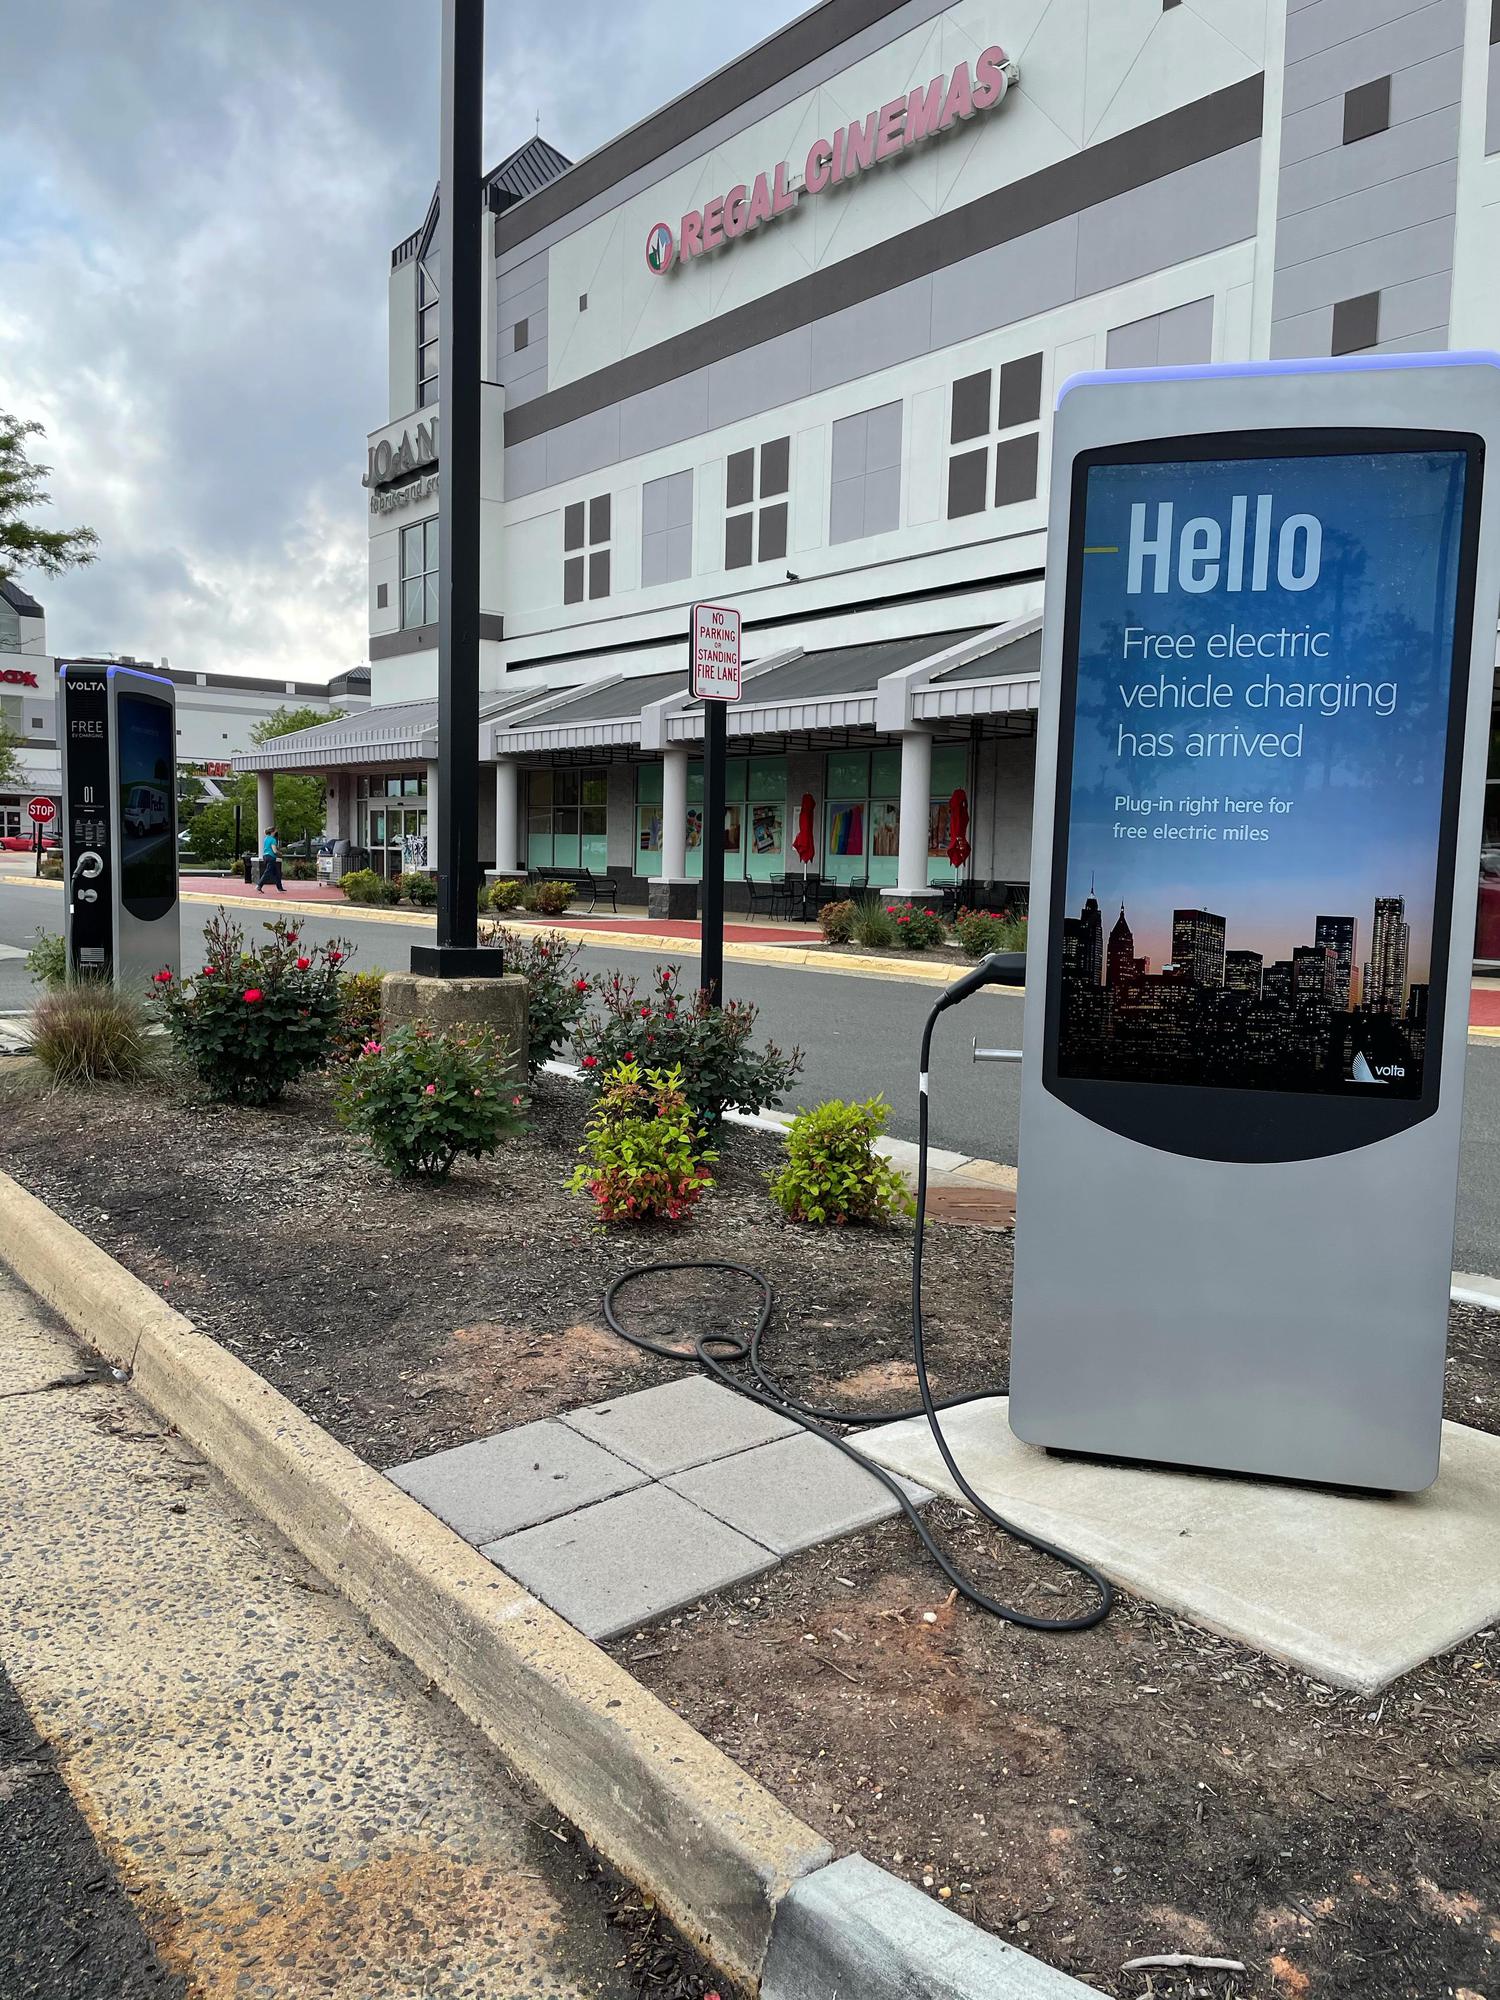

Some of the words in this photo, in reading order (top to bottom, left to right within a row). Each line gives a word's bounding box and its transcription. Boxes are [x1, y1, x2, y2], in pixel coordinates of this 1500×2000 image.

[680, 161, 798, 264] REGAL
[804, 45, 1008, 195] CINEMAS
[1126, 494, 1322, 594] Hello
[712, 612, 724, 625] NO
[700, 626, 736, 642] PARKING
[1122, 627, 1195, 659] Free
[1206, 623, 1330, 659] electric
[698, 648, 737, 665] STANDING
[697, 663, 715, 679] FIRE
[717, 666, 738, 682] LANE
[66, 681, 106, 691] VOLTA
[1118, 674, 1233, 709] vehicle
[1245, 673, 1398, 716] charging
[71, 720, 104, 733] FREE
[1116, 723, 1174, 758] has
[1185, 724, 1303, 758] arrived
[84, 786, 93, 803] 01
[30, 804, 54, 816] STOP
[1114, 796, 1173, 816] Plug-in
[1178, 797, 1219, 816] right
[1224, 797, 1263, 813] here
[1268, 797, 1294, 814] for
[1113, 823, 1147, 840] free
[1153, 824, 1217, 841] electric
[1223, 825, 1269, 842] miles
[1375, 1065, 1405, 1077] volta
